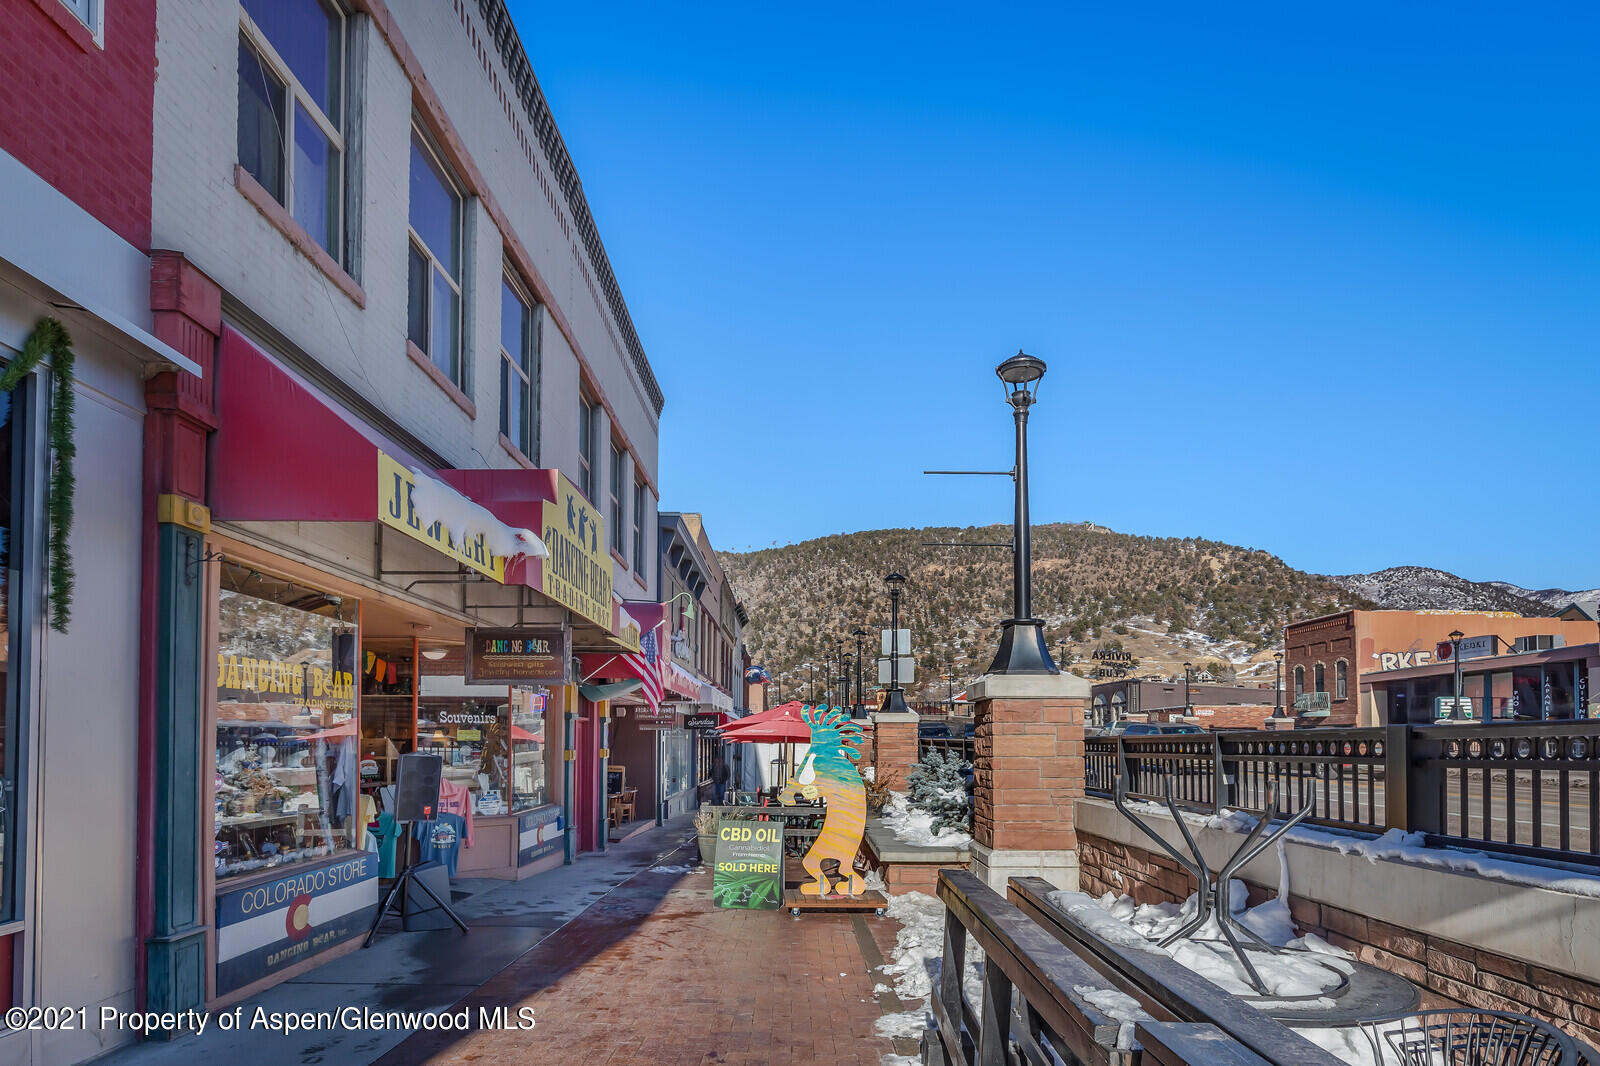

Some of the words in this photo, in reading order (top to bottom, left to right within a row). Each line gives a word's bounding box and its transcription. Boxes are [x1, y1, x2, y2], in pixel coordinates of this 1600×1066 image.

[552, 527, 589, 596] DANCING
[590, 559, 608, 609] BEAR
[293, 697, 331, 710] TRADING
[333, 701, 354, 711] POST
[440, 711, 497, 725] Souvenirs
[720, 827, 752, 842] CBD
[755, 828, 780, 843] OIL
[718, 862, 747, 872] SOLD
[749, 863, 778, 873] HERE
[241, 871, 325, 914] COLORADO
[328, 858, 367, 887] STORE
[268, 941, 309, 966] DANCING
